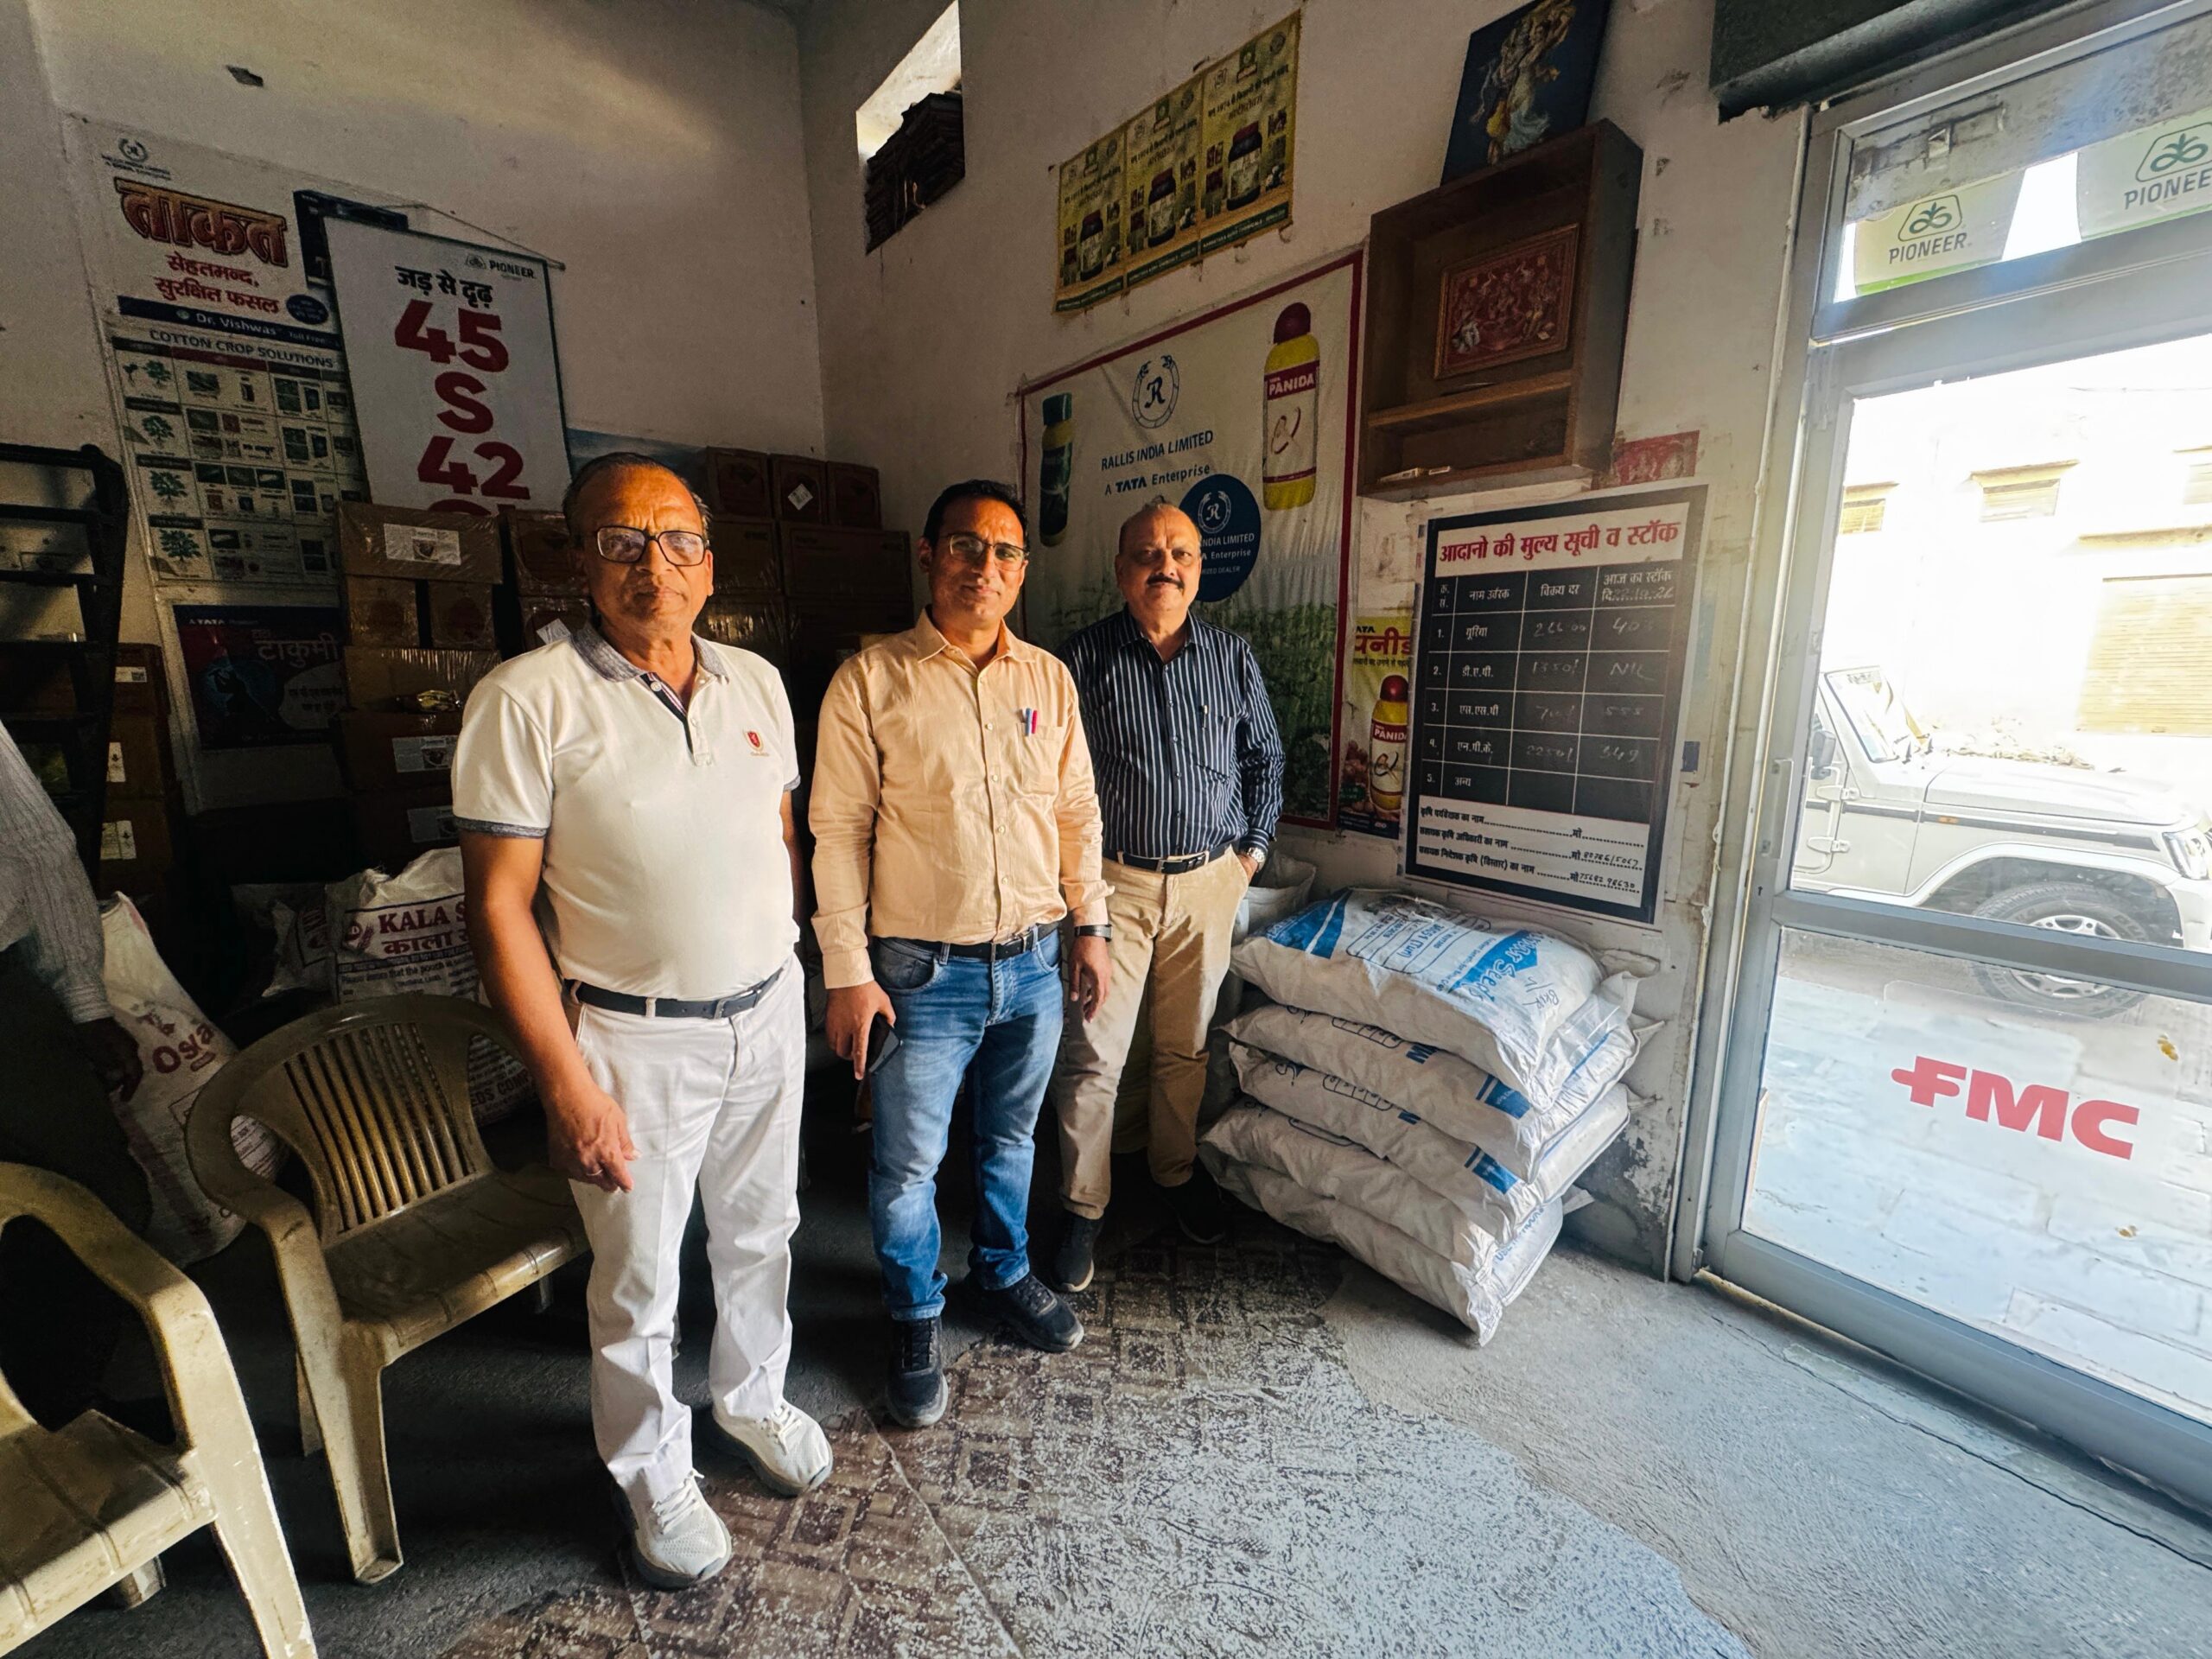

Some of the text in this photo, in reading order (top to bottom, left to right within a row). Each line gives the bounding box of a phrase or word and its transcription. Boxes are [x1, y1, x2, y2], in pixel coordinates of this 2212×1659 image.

[2124, 168, 2212, 210] PIONEE
[114, 176, 289, 268] ताकत
[1888, 232, 1967, 264] PIONEER
[395, 266, 432, 296] जड़
[435, 270, 457, 295] से
[489, 260, 537, 278] PIONEER
[153, 276, 222, 300] सुरक्षित
[226, 289, 279, 313] फसल
[195, 312, 217, 327] Dr.
[219, 317, 277, 336] Vishwas
[395, 299, 509, 372] 45
[149, 329, 211, 348] COTTON
[216, 341, 254, 355] CROP
[258, 346, 334, 368] SOLUTIONS
[1268, 372, 1314, 396] PANIDA
[435, 372, 493, 434] S
[1101, 430, 1214, 471] RALLIS INDIA LIMITED
[417, 435, 531, 499] 42
[1105, 463, 1211, 496] A TATA Enterprise
[1202, 532, 1255, 547] NDIA LIMITED
[1440, 535, 1488, 563] आदानो
[1493, 532, 1515, 557] की
[1564, 524, 1600, 556] सूची
[1606, 527, 1621, 547] व
[1628, 519, 1681, 546] स्टॉक
[1211, 548, 1252, 560] Enterprise
[1568, 583, 1581, 595] दर
[1603, 567, 1673, 586] आज का स्टॉक
[1469, 590, 1485, 601] नाम
[198, 618, 226, 626] TATA
[1438, 628, 1445, 638] 1.
[1433, 665, 1442, 676] 2.
[1431, 703, 1440, 712] 3.
[1427, 774, 1435, 783] 5.
[1495, 838, 1509, 849] नाम
[1521, 863, 1535, 874] नाम
[378, 906, 449, 933] KALA
[381, 930, 453, 955] काला
[1467, 958, 1518, 1002] Seeds
[1891, 1056, 2139, 1160] FMC
